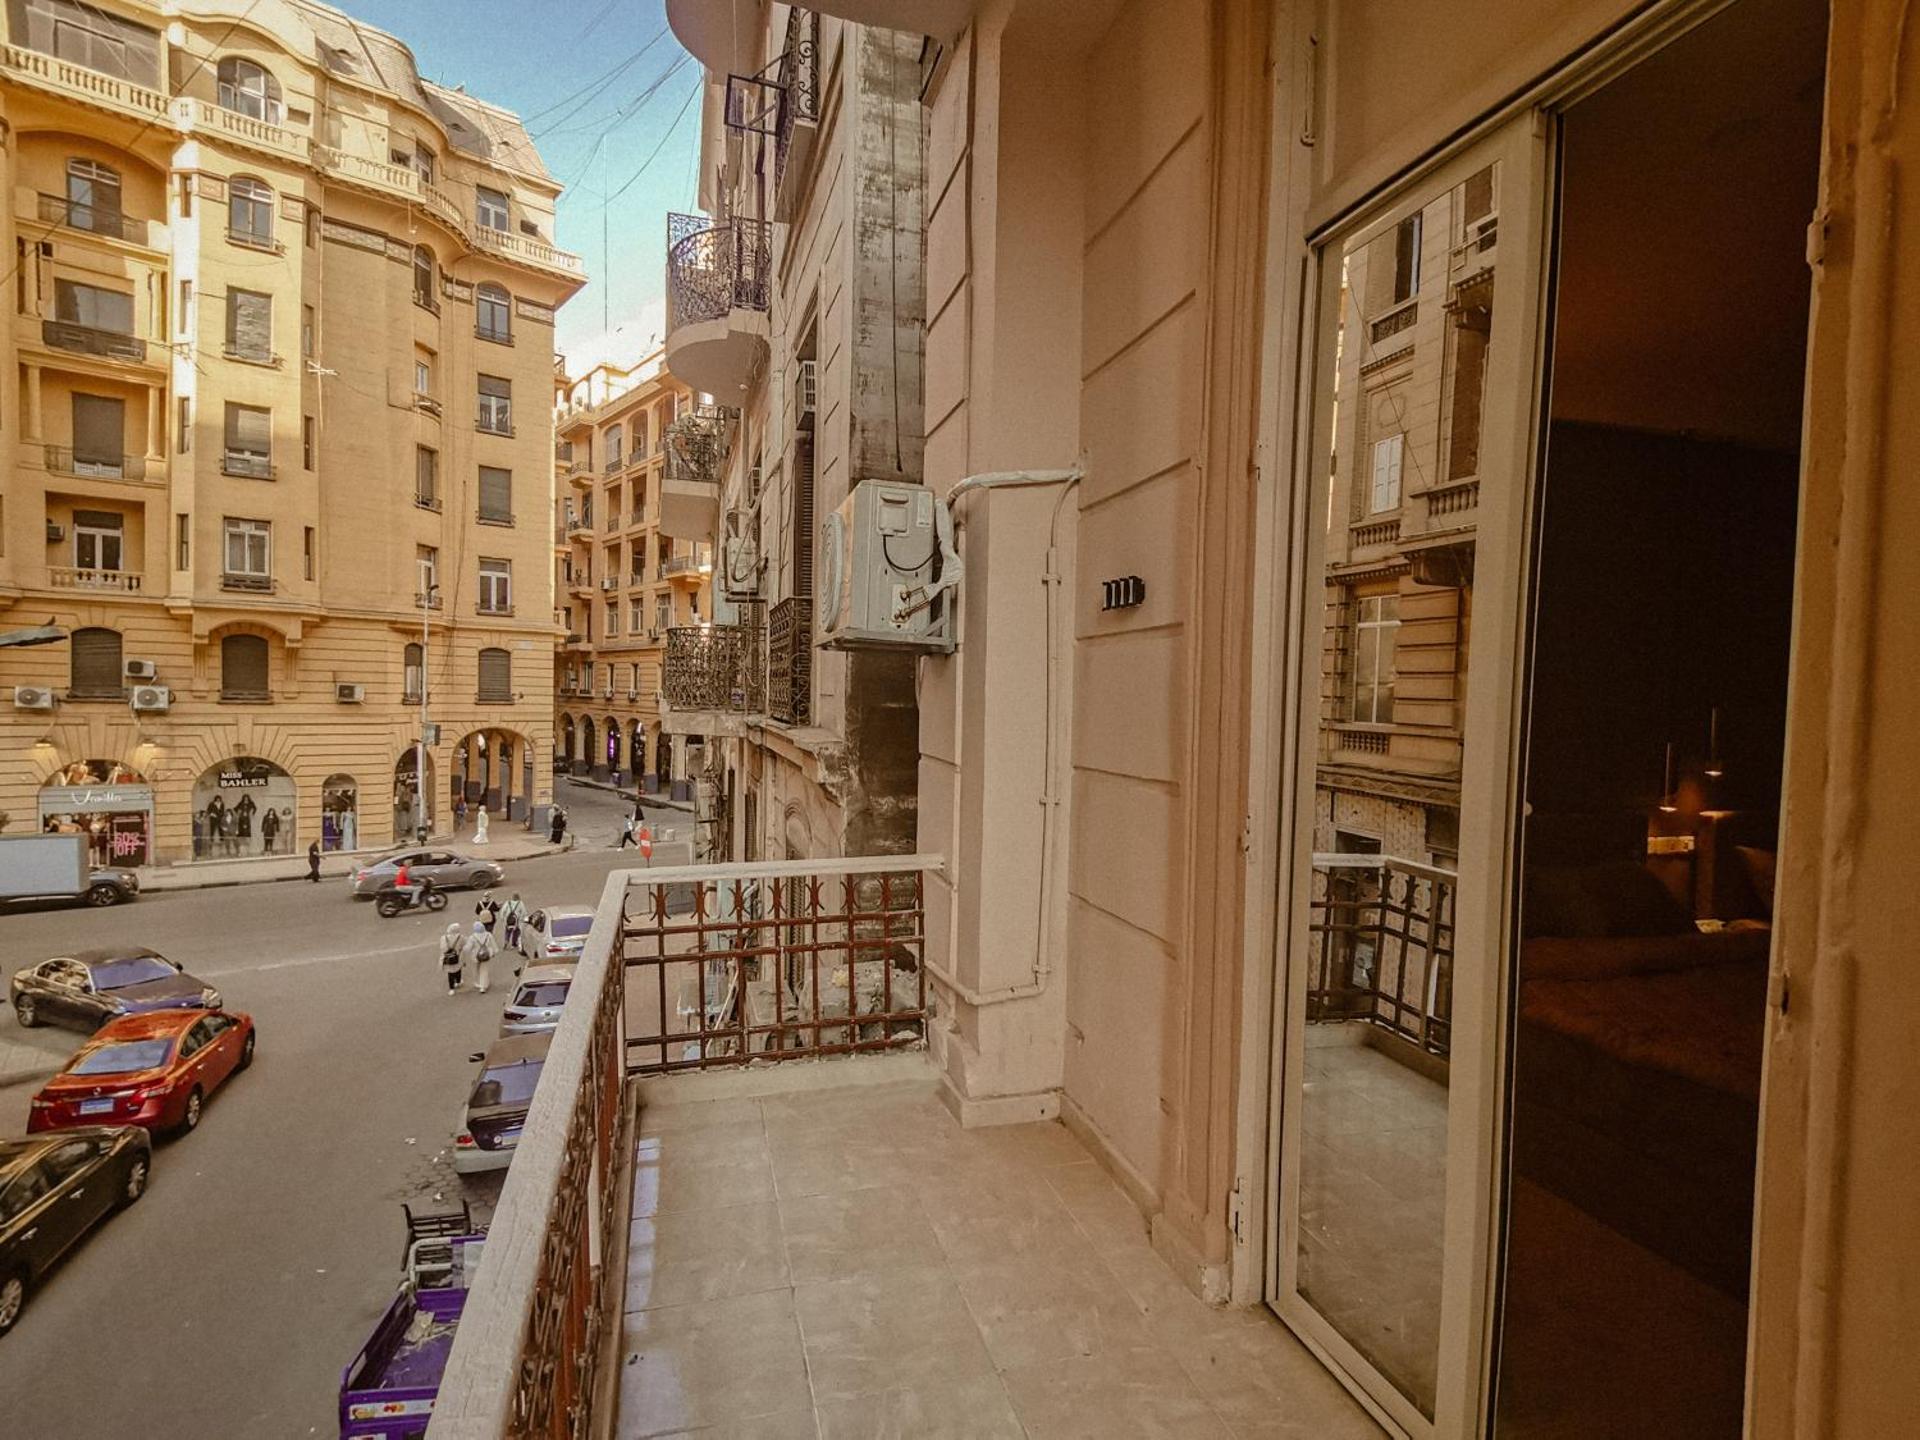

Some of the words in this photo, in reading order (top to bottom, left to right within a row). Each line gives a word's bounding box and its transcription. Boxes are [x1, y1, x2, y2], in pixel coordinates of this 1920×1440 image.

[221, 771, 243, 779] MISS
[220, 779, 267, 787] BAHLER
[117, 844, 137, 856] OFF
